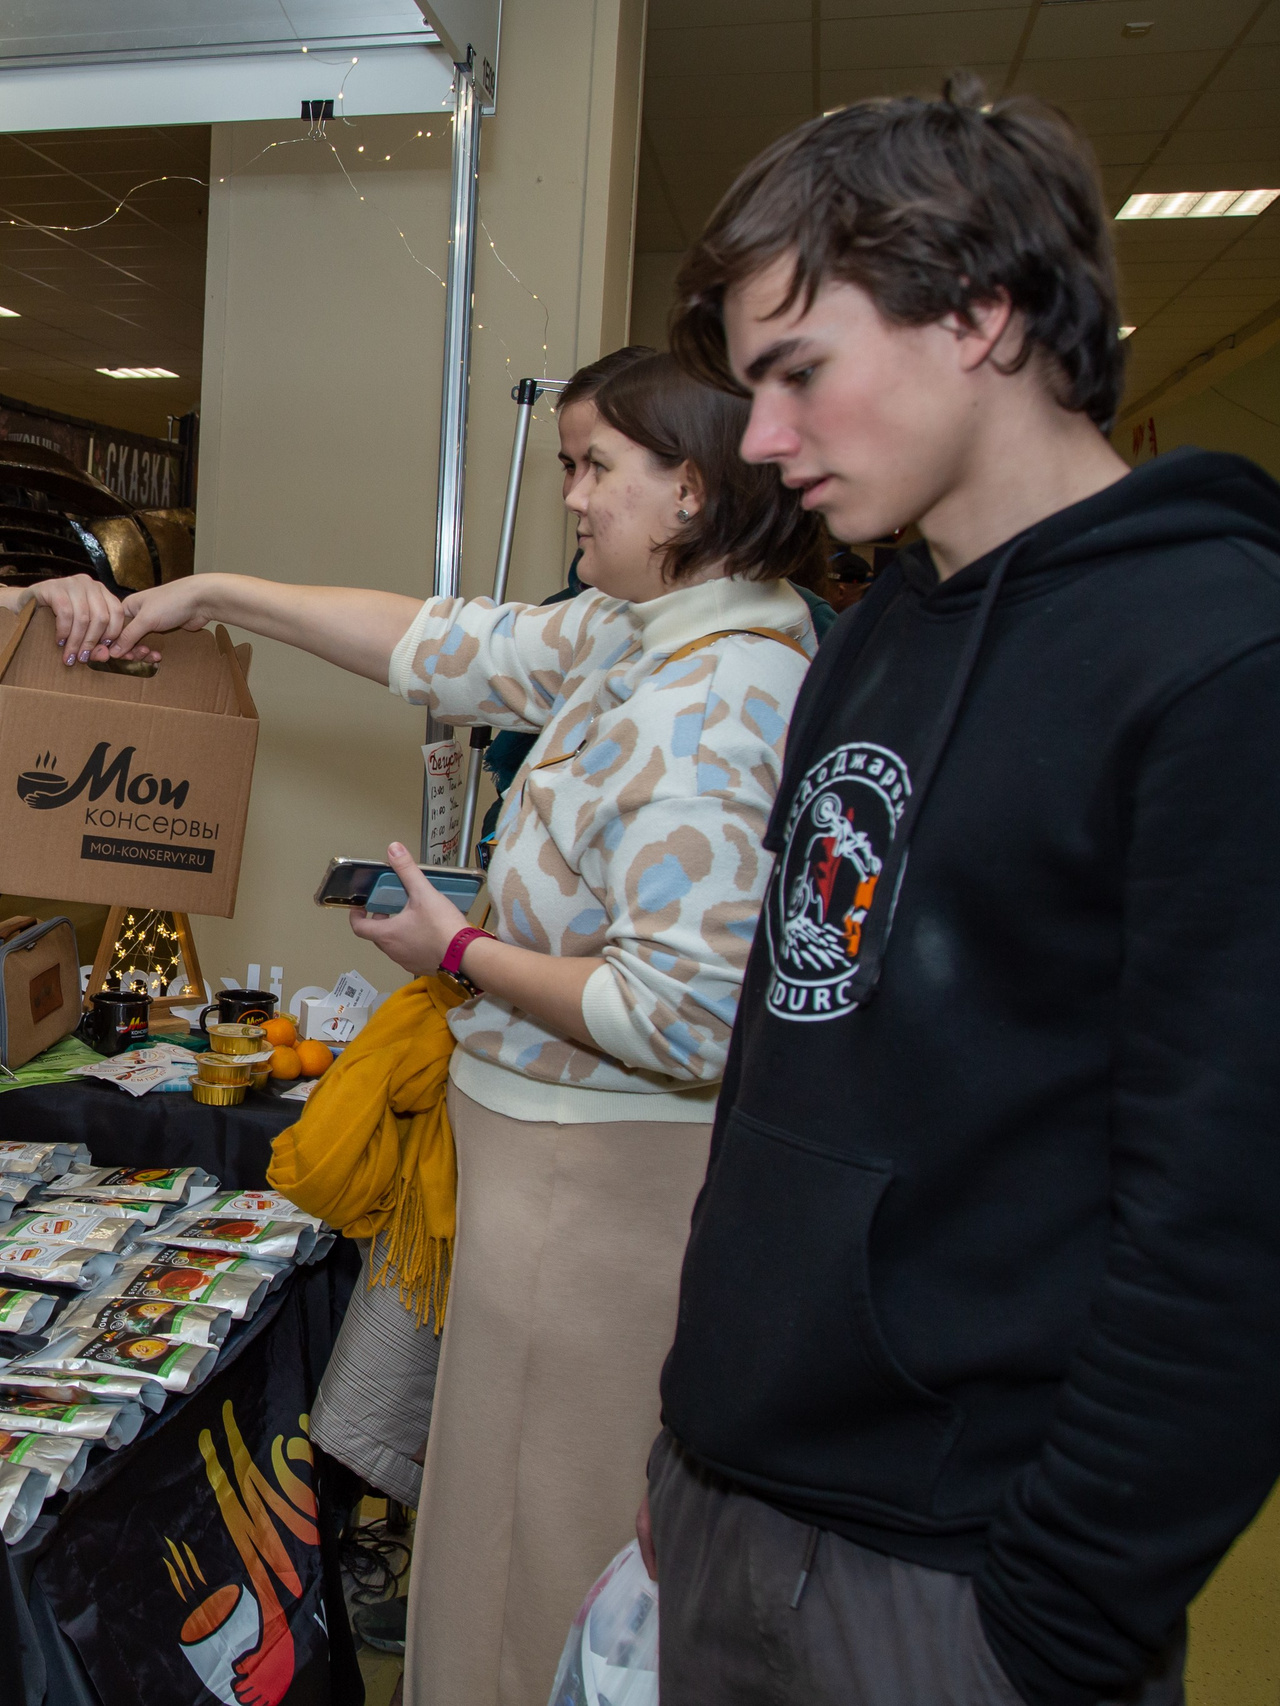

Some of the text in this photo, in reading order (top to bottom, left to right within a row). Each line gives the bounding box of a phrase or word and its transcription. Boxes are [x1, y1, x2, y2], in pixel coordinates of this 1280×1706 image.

[105, 442, 172, 507] СКАЗКА
[70, 741, 191, 811] Мои
[84, 807, 220, 840] консервы
[89, 842, 207, 867] MOI-KONSERVY.RU
